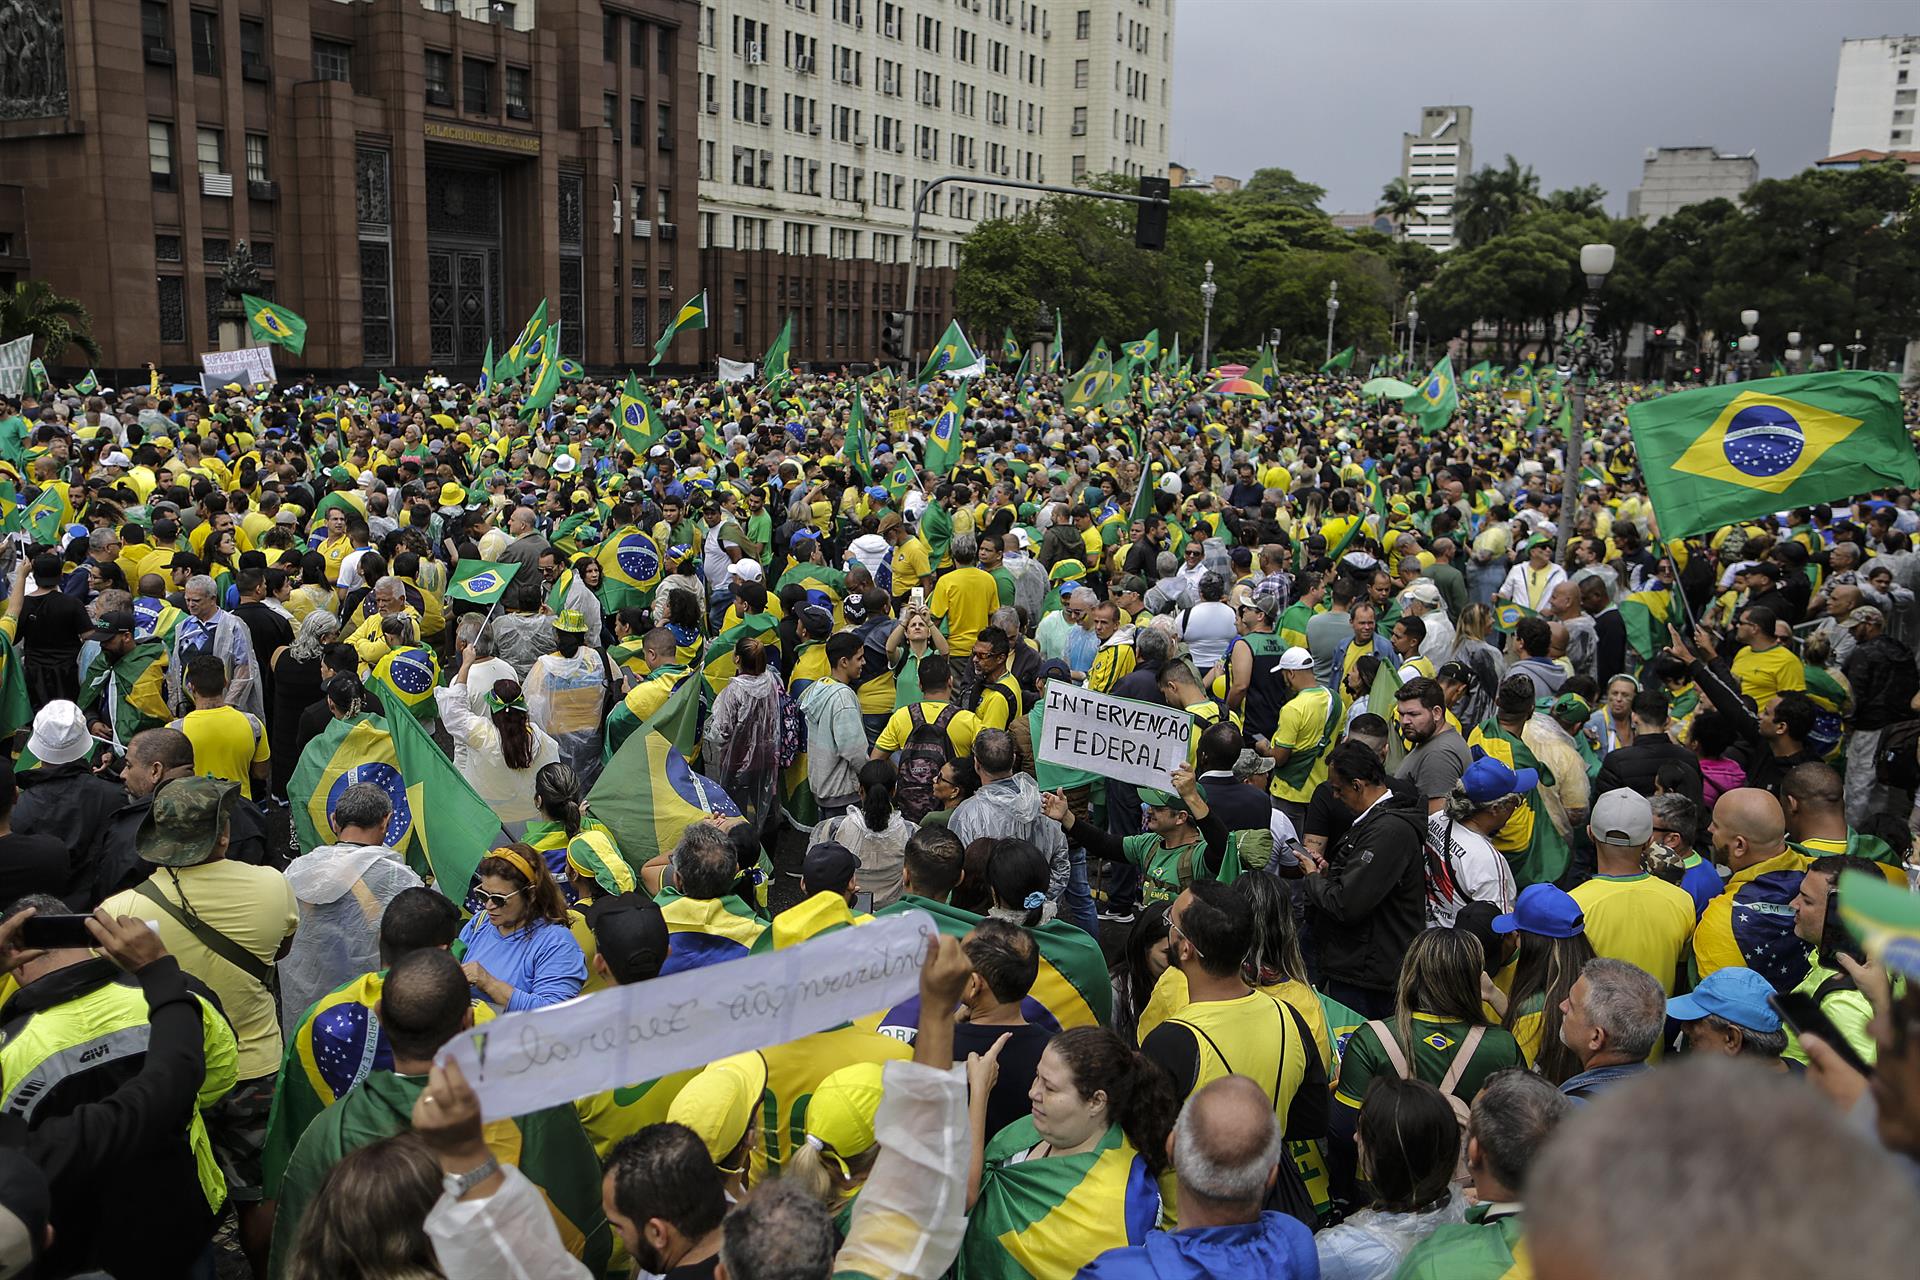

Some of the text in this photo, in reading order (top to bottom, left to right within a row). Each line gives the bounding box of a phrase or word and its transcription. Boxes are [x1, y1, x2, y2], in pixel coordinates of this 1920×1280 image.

[1047, 690, 1190, 742] INTERVENÇÃO
[1054, 725, 1167, 773] FEDERAL
[80, 1044, 110, 1063] GIVI
[366, 1016, 378, 1053] ORDEM
